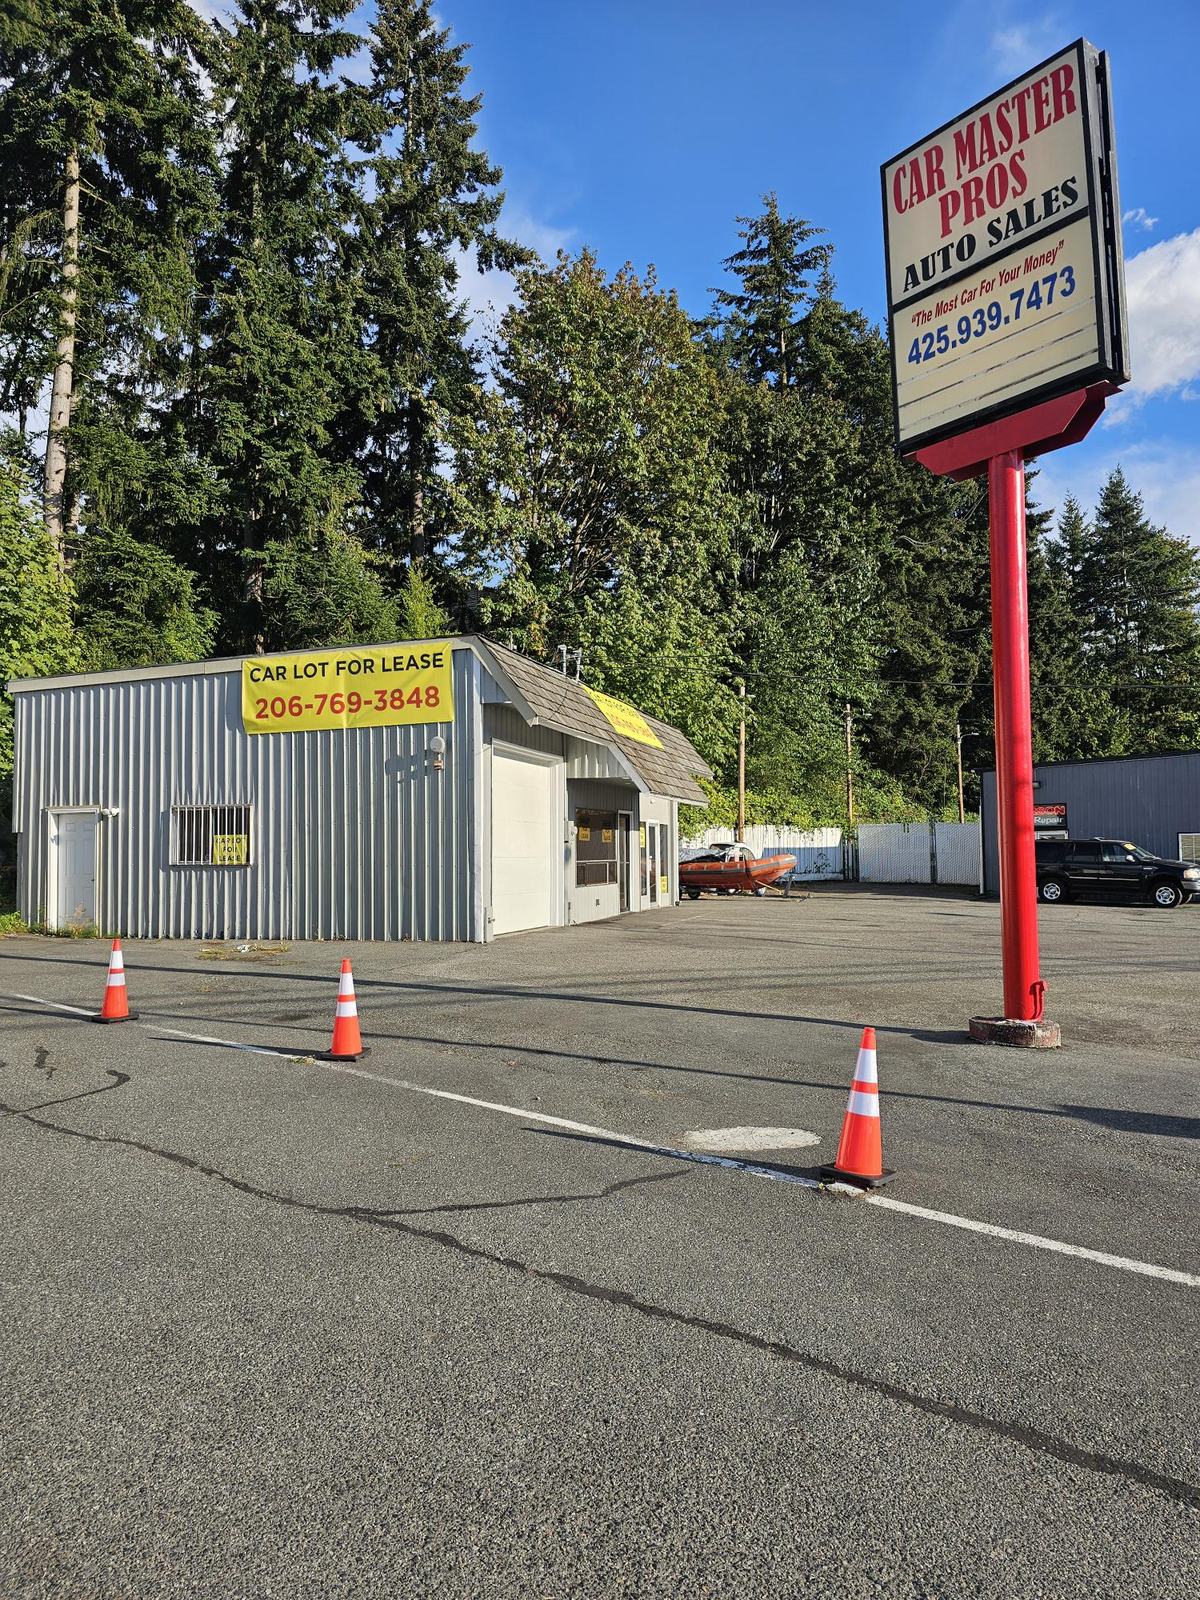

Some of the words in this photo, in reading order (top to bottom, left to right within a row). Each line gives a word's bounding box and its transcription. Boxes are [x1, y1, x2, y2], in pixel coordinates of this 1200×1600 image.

[893, 145, 946, 214] CAR
[953, 64, 1077, 180] MASTER
[938, 149, 1028, 239] PROS
[903, 233, 976, 293] AUTO
[986, 176, 1079, 248] SALES
[908, 265, 1076, 365] 425.939.7473
[934, 293, 959, 315] Most
[960, 288, 977, 306] Car
[979, 277, 996, 297] For
[998, 265, 1022, 287] Your
[249, 665, 287, 683] CAR
[293, 662, 329, 679] LOT
[336, 658, 375, 676] FOR
[381, 652, 444, 672] LEASE
[255, 685, 441, 720] 206-769-3848
[1034, 816, 1064, 825] Repair
